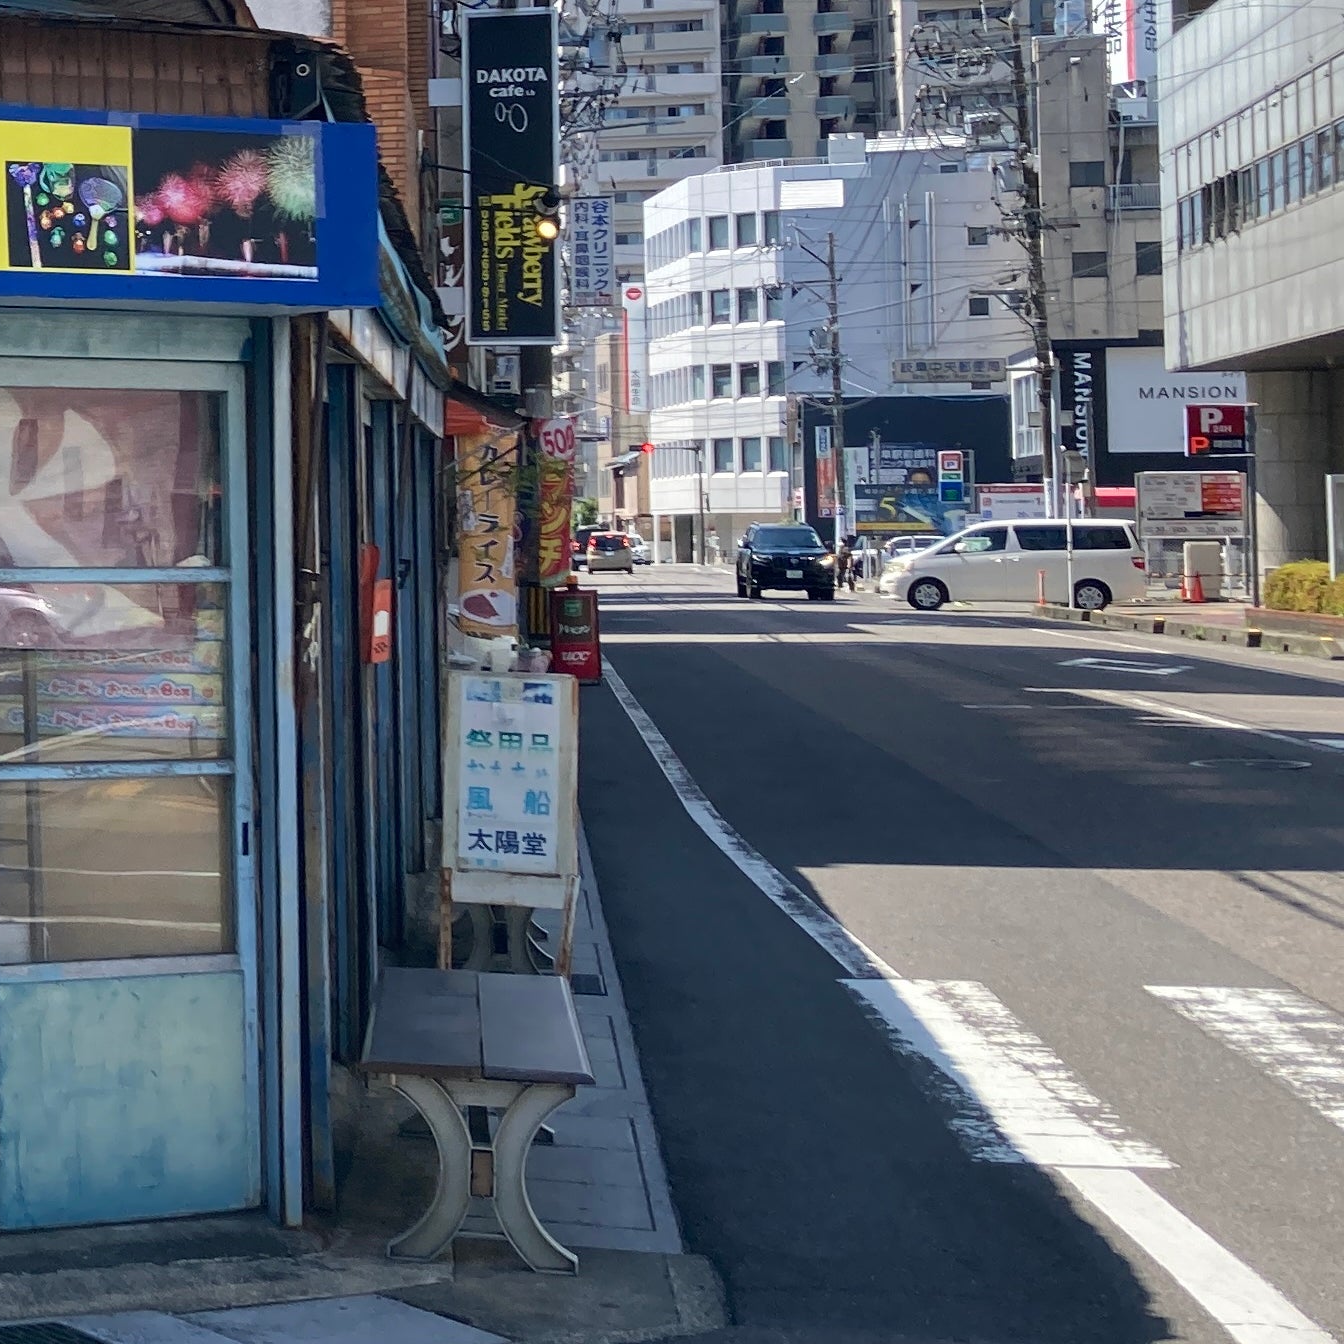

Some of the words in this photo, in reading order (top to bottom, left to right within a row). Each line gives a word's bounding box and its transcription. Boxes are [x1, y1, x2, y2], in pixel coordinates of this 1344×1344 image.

[476, 67, 548, 83] DAKOTA
[489, 84, 524, 97] cafe
[591, 200, 609, 291] 谷本クリニック
[1139, 386, 1238, 399] MANSION
[1199, 407, 1223, 434] P
[542, 425, 575, 456] 500
[1190, 437, 1210, 454] P
[468, 828, 548, 857] 太陽堂
